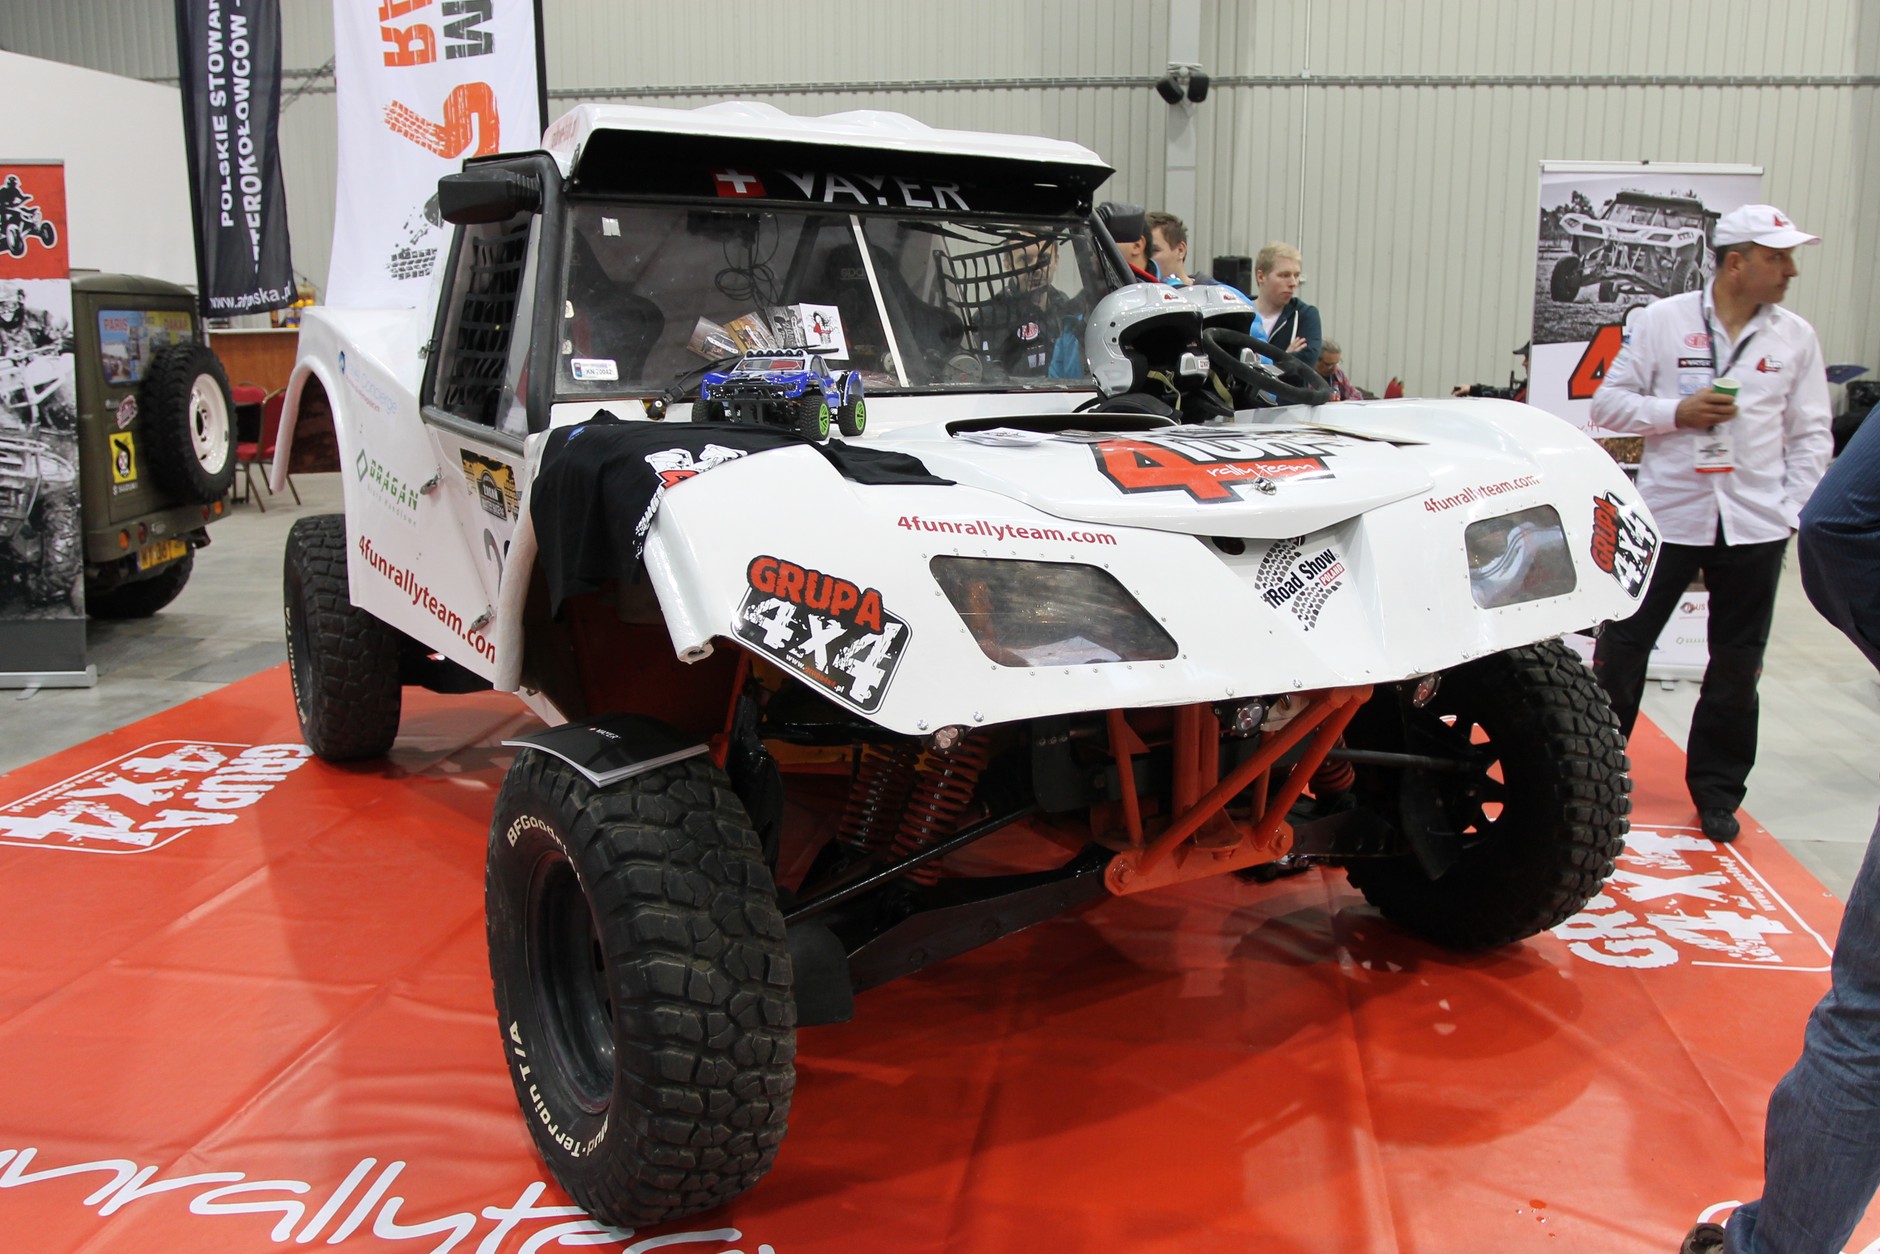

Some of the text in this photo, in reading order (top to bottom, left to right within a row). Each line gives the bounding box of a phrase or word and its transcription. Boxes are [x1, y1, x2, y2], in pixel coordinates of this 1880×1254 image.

[212, 115, 234, 227] POLSKIE
[370, 458, 418, 511] DRAGAN
[897, 515, 1118, 546] 4funrallyteam.com
[1298, 548, 1337, 581] Show
[1319, 562, 1345, 586] POLAND
[750, 557, 881, 631] GRUPA
[509, 1020, 531, 1082] T/A
